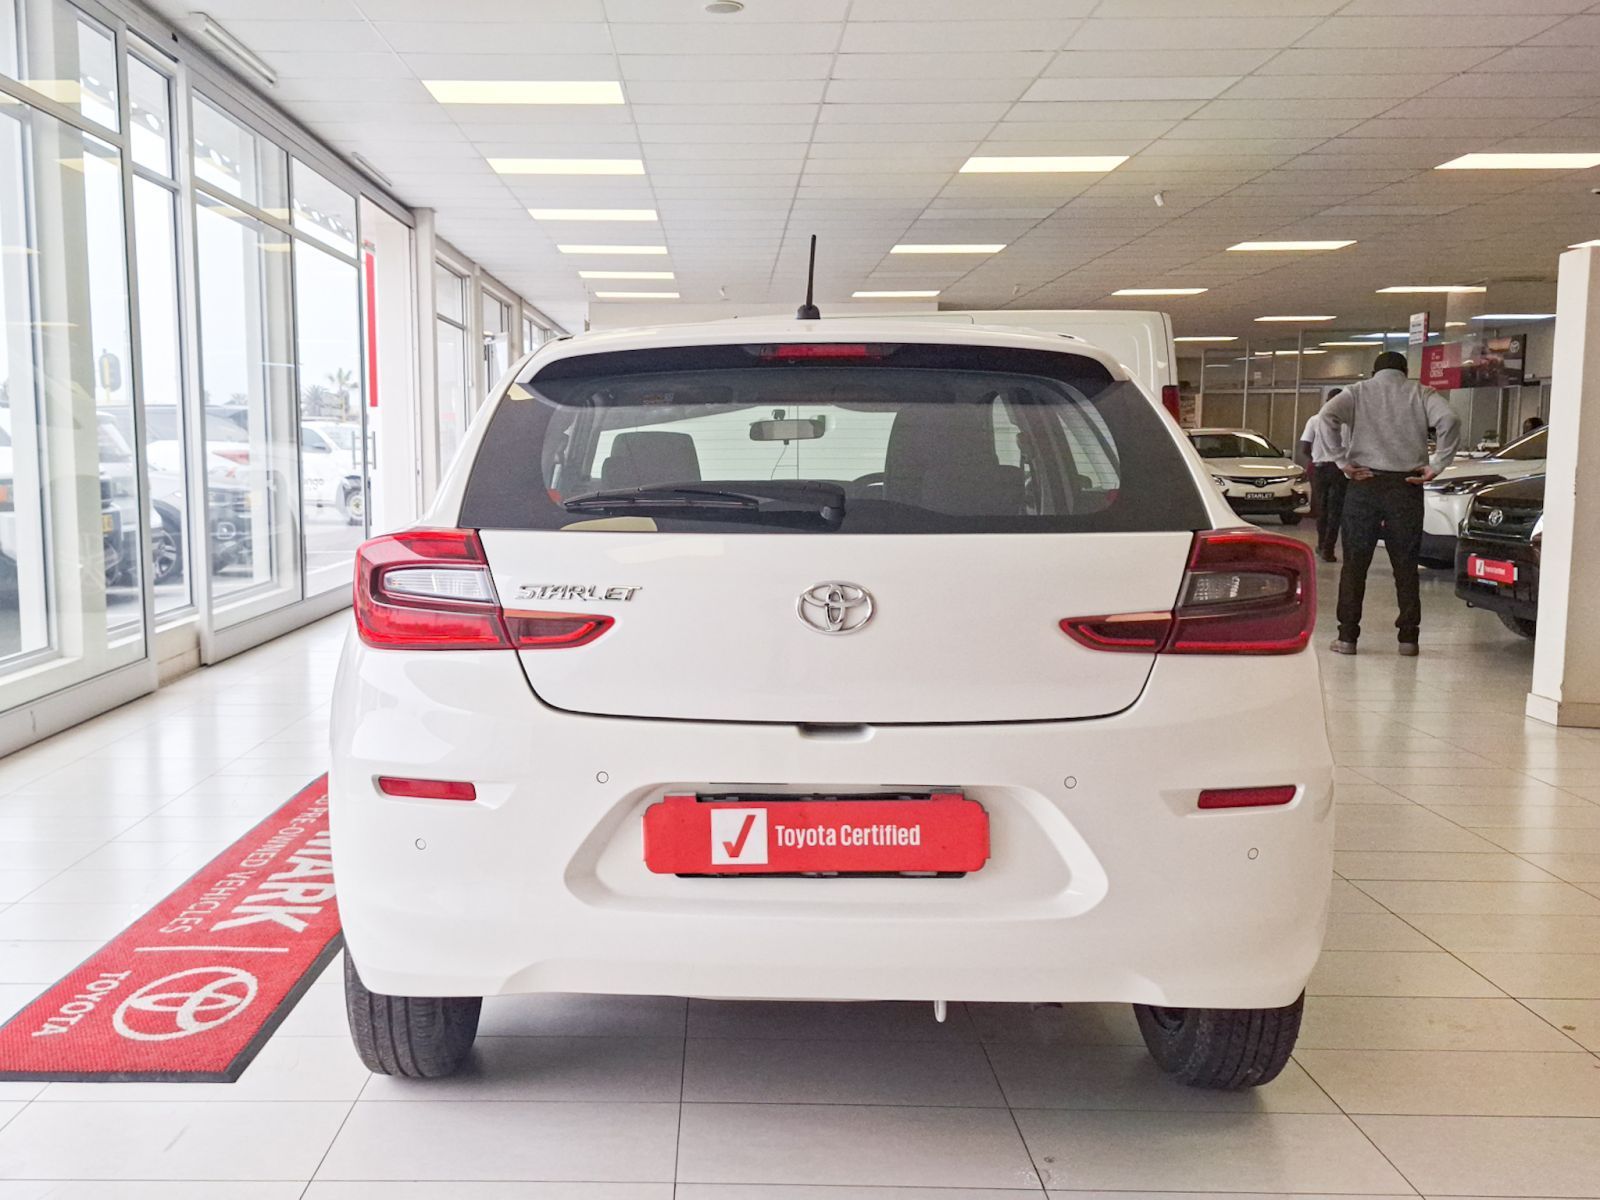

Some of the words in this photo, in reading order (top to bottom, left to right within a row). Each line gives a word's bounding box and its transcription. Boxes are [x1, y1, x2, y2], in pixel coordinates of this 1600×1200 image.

[515, 584, 643, 601] STARLET
[240, 807, 327, 868] PRE-OWNED
[775, 825, 837, 849] Toyota
[840, 824, 921, 847] Certified
[158, 870, 257, 934] VEHICLES
[31, 969, 132, 1038] TOYOTA
